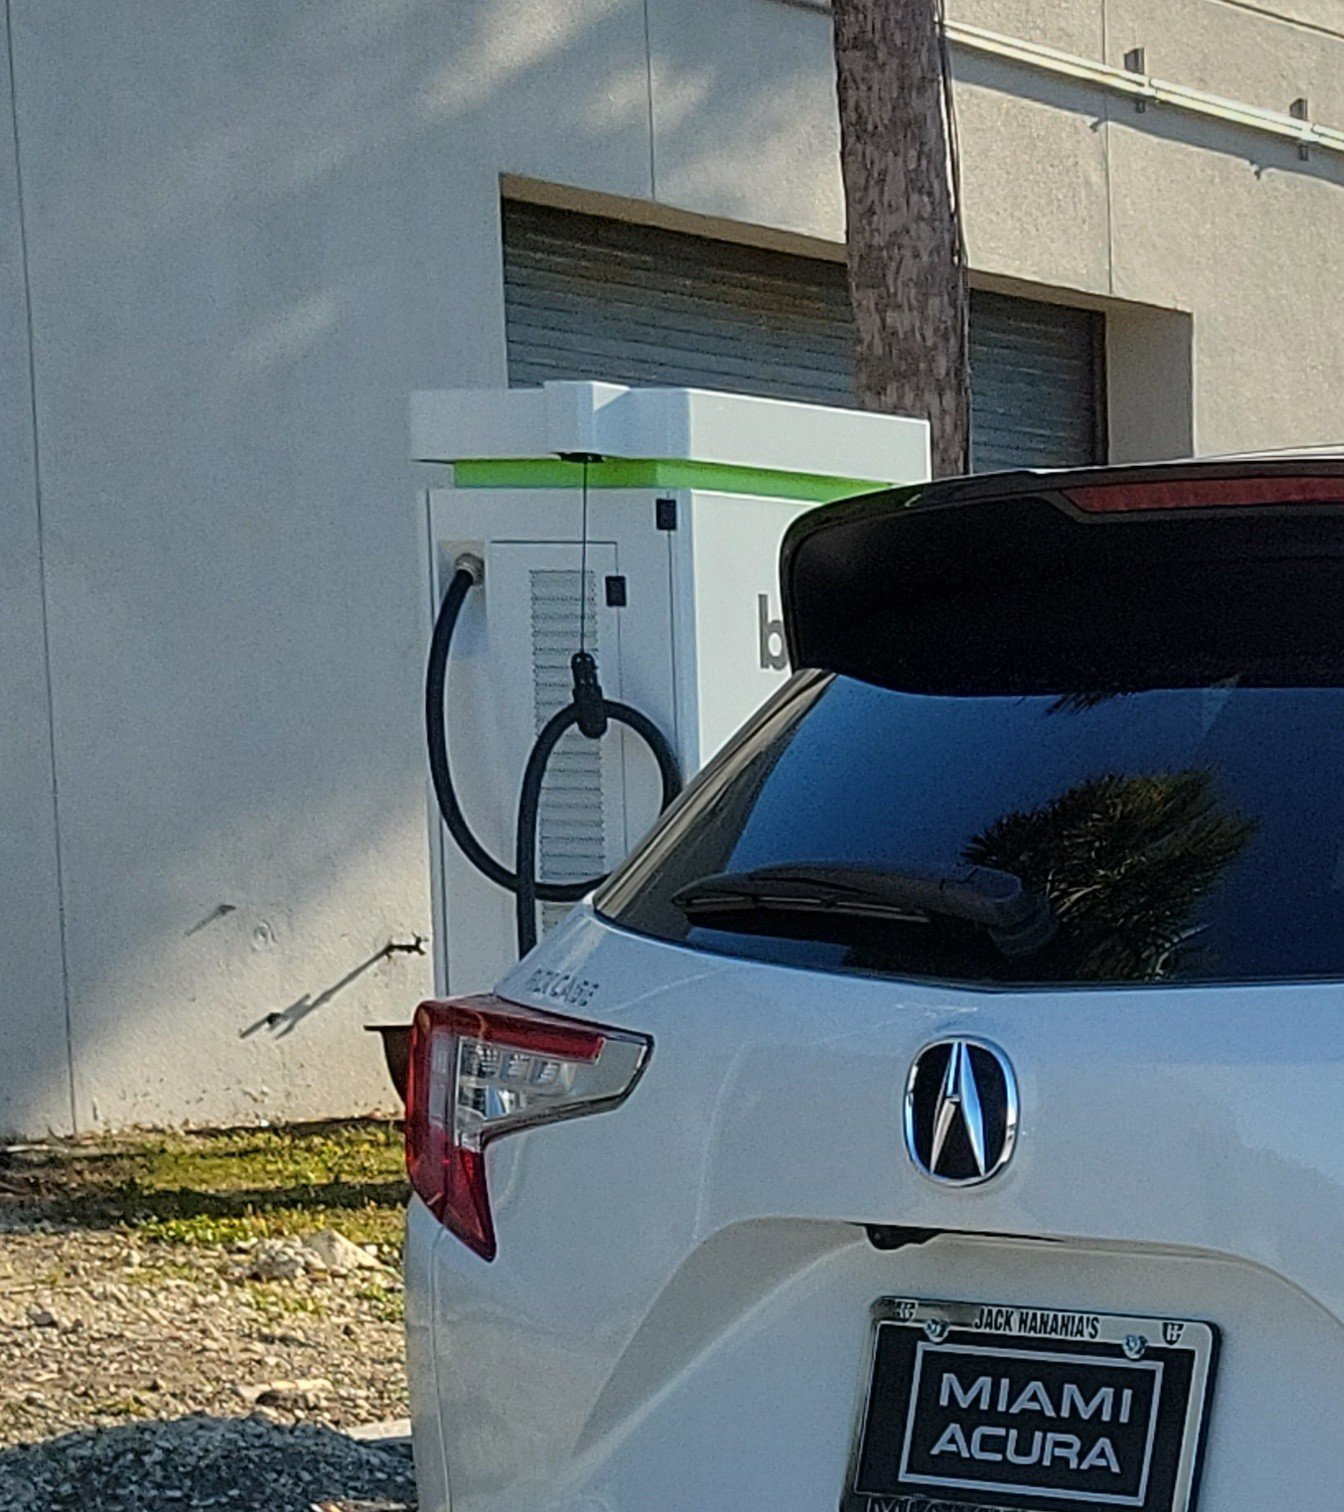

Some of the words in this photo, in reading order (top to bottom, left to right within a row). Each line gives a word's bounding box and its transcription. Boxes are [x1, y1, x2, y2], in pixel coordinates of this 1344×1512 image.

[974, 1308, 1014, 1332] JACK
[939, 1372, 1133, 1424] MIAMI
[930, 1423, 1121, 1473] ACURA
